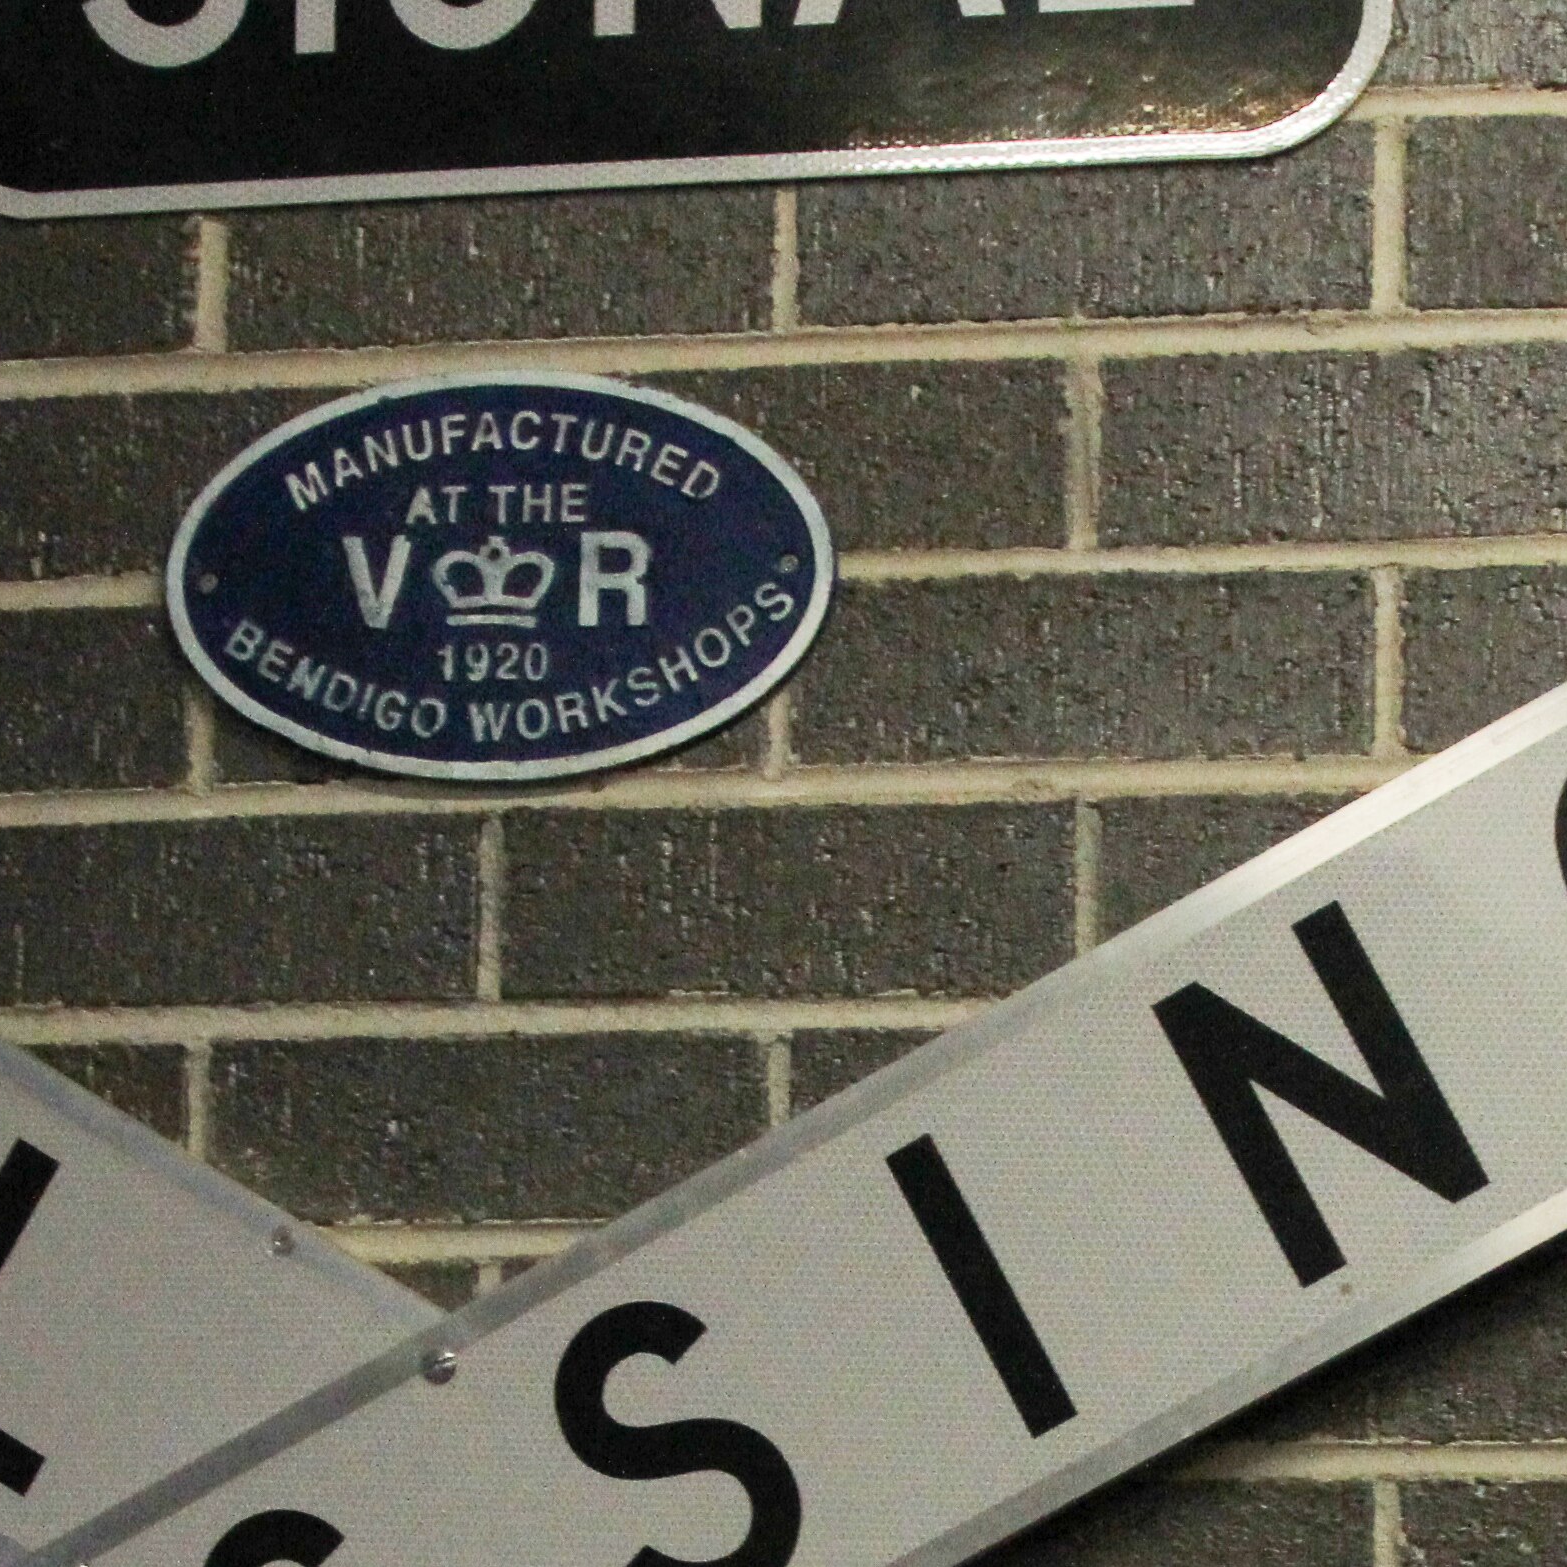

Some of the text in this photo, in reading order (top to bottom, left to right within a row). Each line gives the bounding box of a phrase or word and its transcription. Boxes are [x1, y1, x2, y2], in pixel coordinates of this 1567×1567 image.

[285, 410, 721, 513] MANUFACTURED
[406, 483, 591, 526] AT THE
[342, 530, 654, 630] V R
[224, 580, 796, 743] BENDIGO WORKSHOPS
[439, 643, 550, 682] 1920
